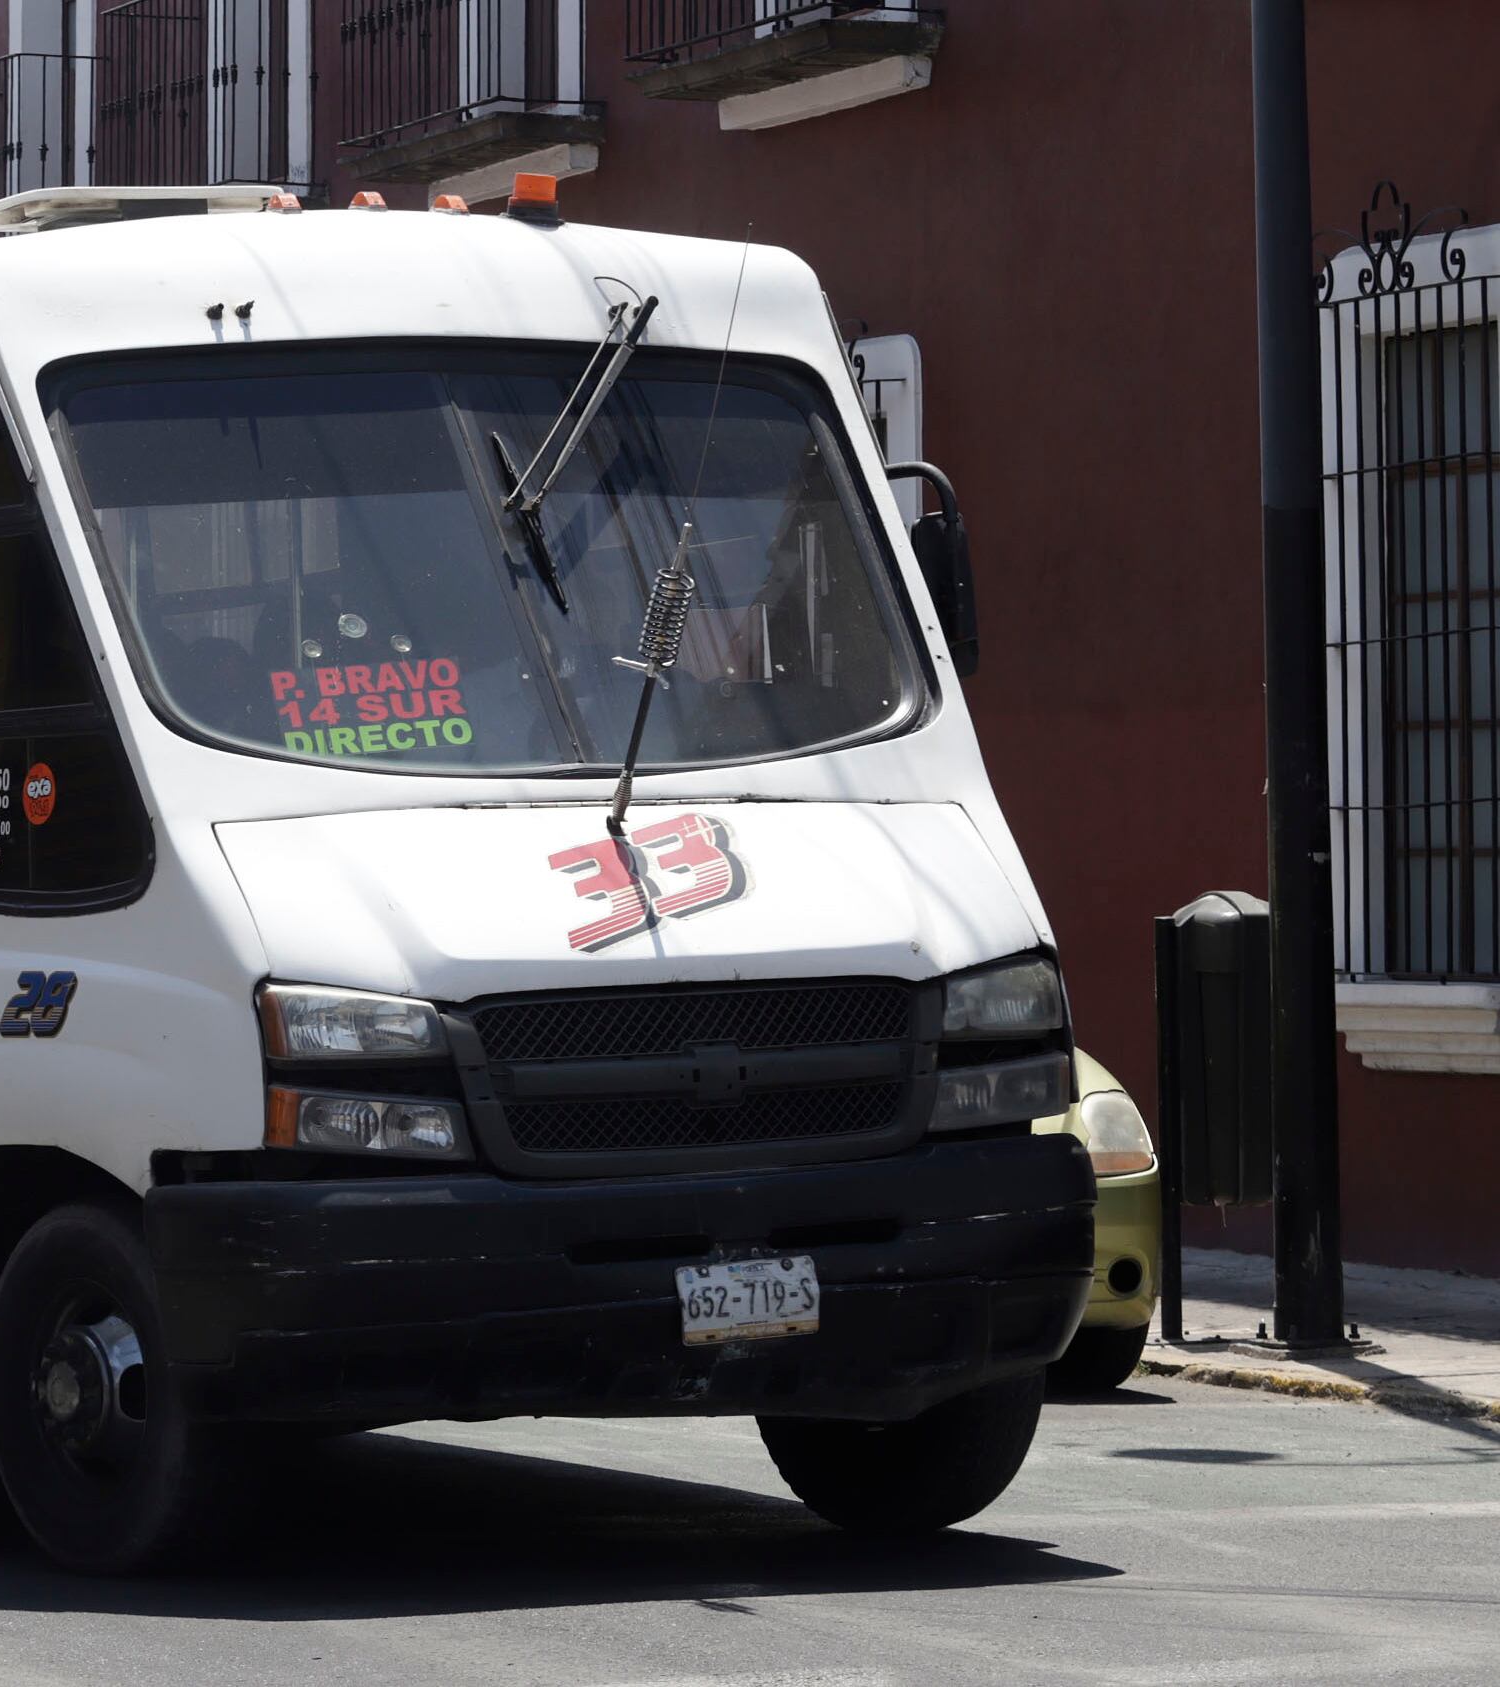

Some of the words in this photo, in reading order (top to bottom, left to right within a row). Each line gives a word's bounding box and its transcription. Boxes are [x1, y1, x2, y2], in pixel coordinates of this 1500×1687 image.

[270, 670, 305, 699] P.
[316, 658, 460, 696] BRAVO
[279, 698, 341, 728] 14
[357, 689, 467, 722] SUR
[284, 717, 473, 756] DIRECTO
[27, 778, 52, 799] exa
[547, 812, 748, 954] 33
[687, 1276, 816, 1320] 652-719-S
